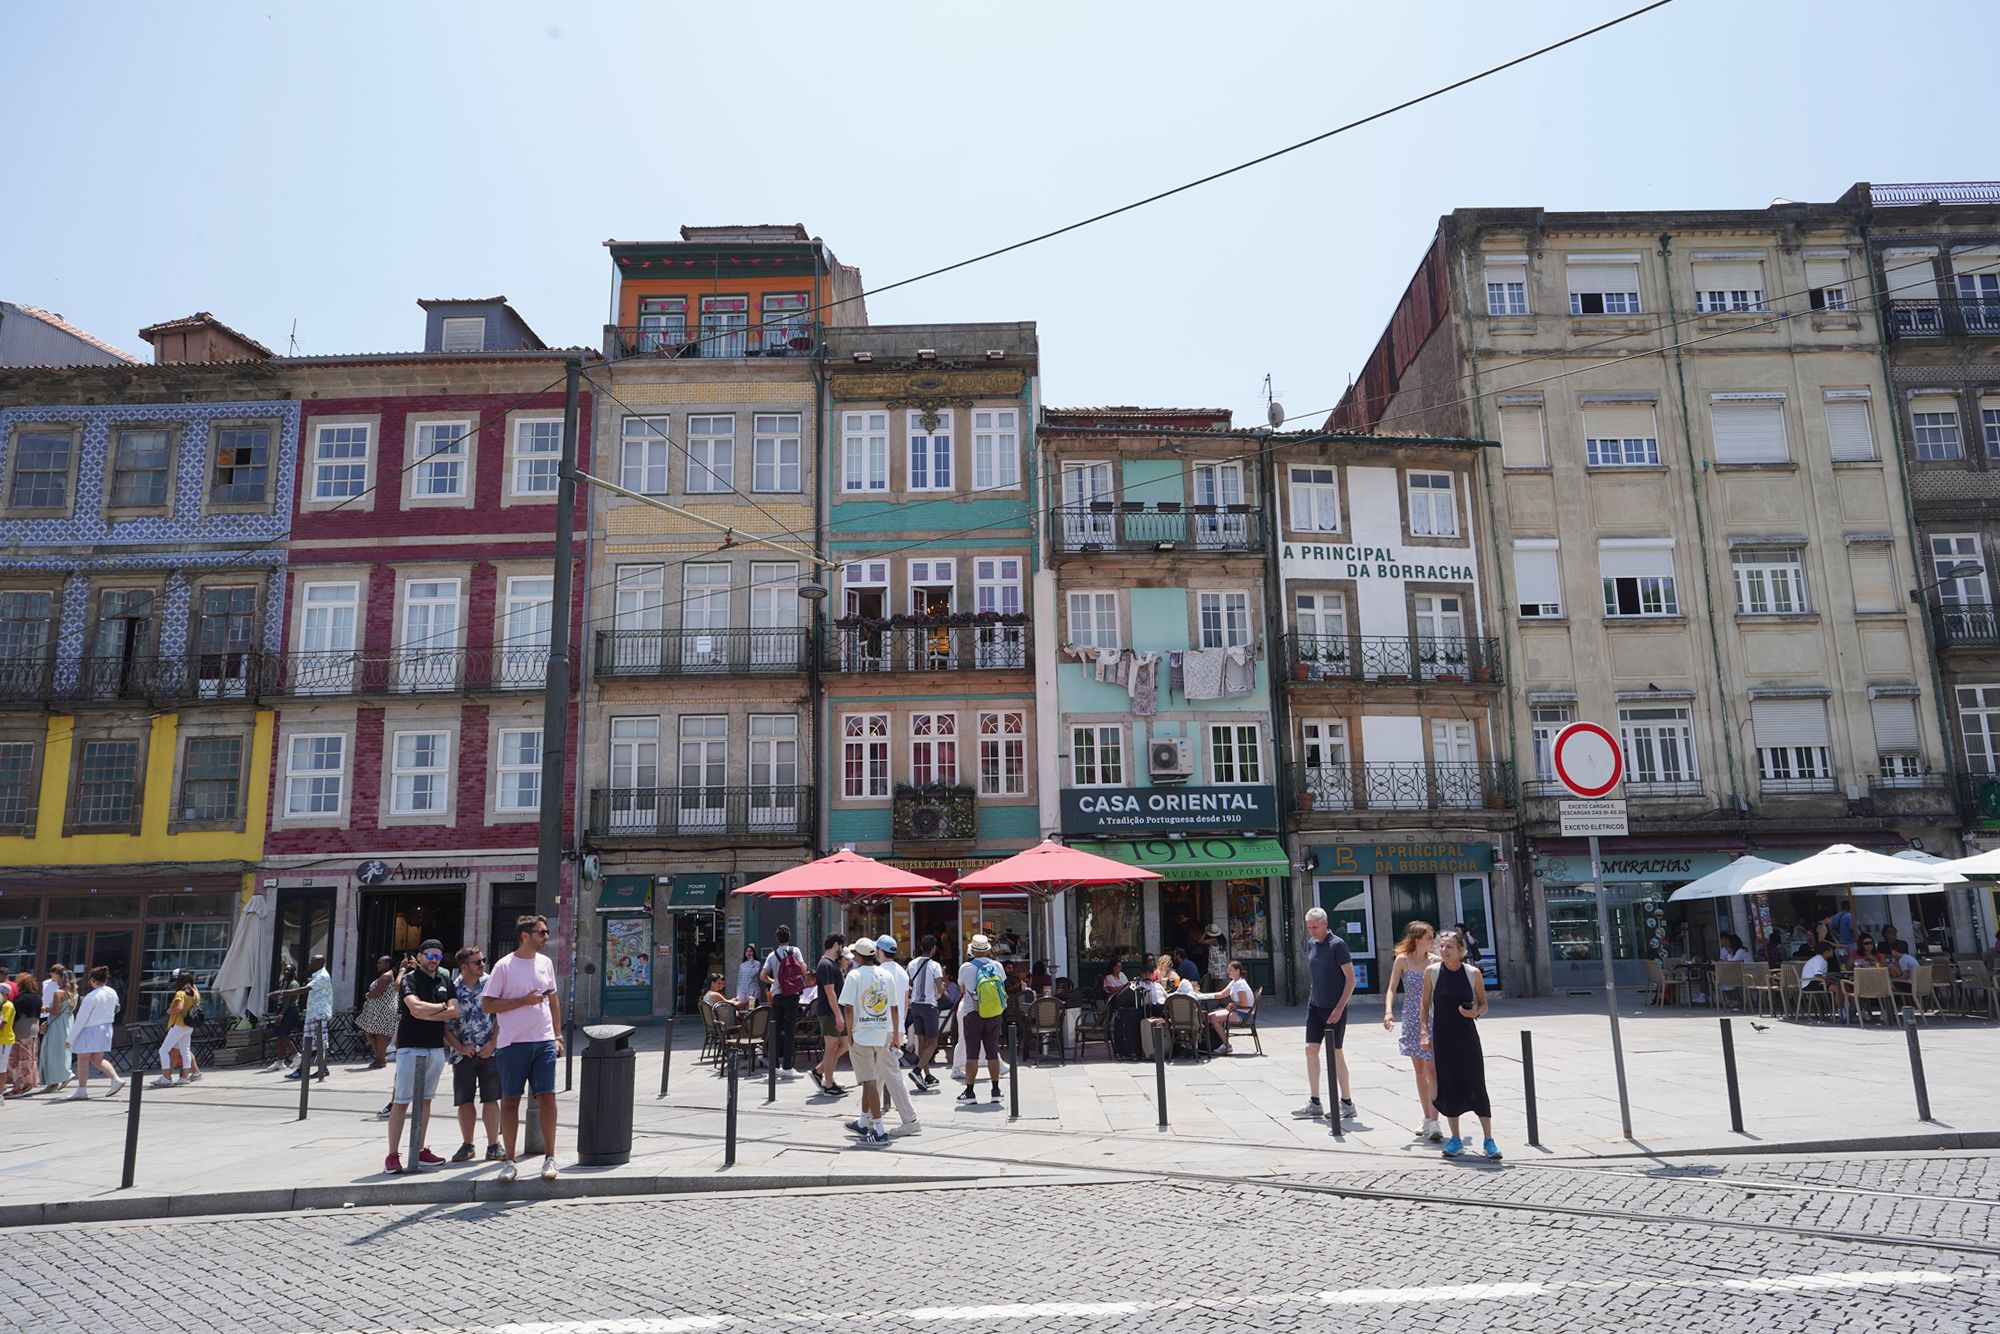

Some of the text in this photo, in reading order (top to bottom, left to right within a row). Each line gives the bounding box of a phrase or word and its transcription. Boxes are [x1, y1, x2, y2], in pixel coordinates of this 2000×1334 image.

[1283, 545, 1396, 562] A PRINCIPAL
[1347, 564, 1474, 580] DA BORRACHA
[1079, 793, 1259, 813] CASA ORIENTAL
[1099, 814, 1242, 826] A Tradição Portuguesa desde 1910
[1128, 839, 1237, 863] 1910
[1375, 846, 1464, 857] A PRINCIPAL
[389, 861, 471, 881] Amorino
[925, 861, 936, 869] DO
[937, 860, 965, 869] PASTEL
[967, 859, 976, 868] DE
[1376, 860, 1478, 873] DA BORRACHA
[1600, 859, 1692, 875] MURALHAS
[1216, 869, 1233, 878] DO
[1239, 867, 1279, 877] PORTO
